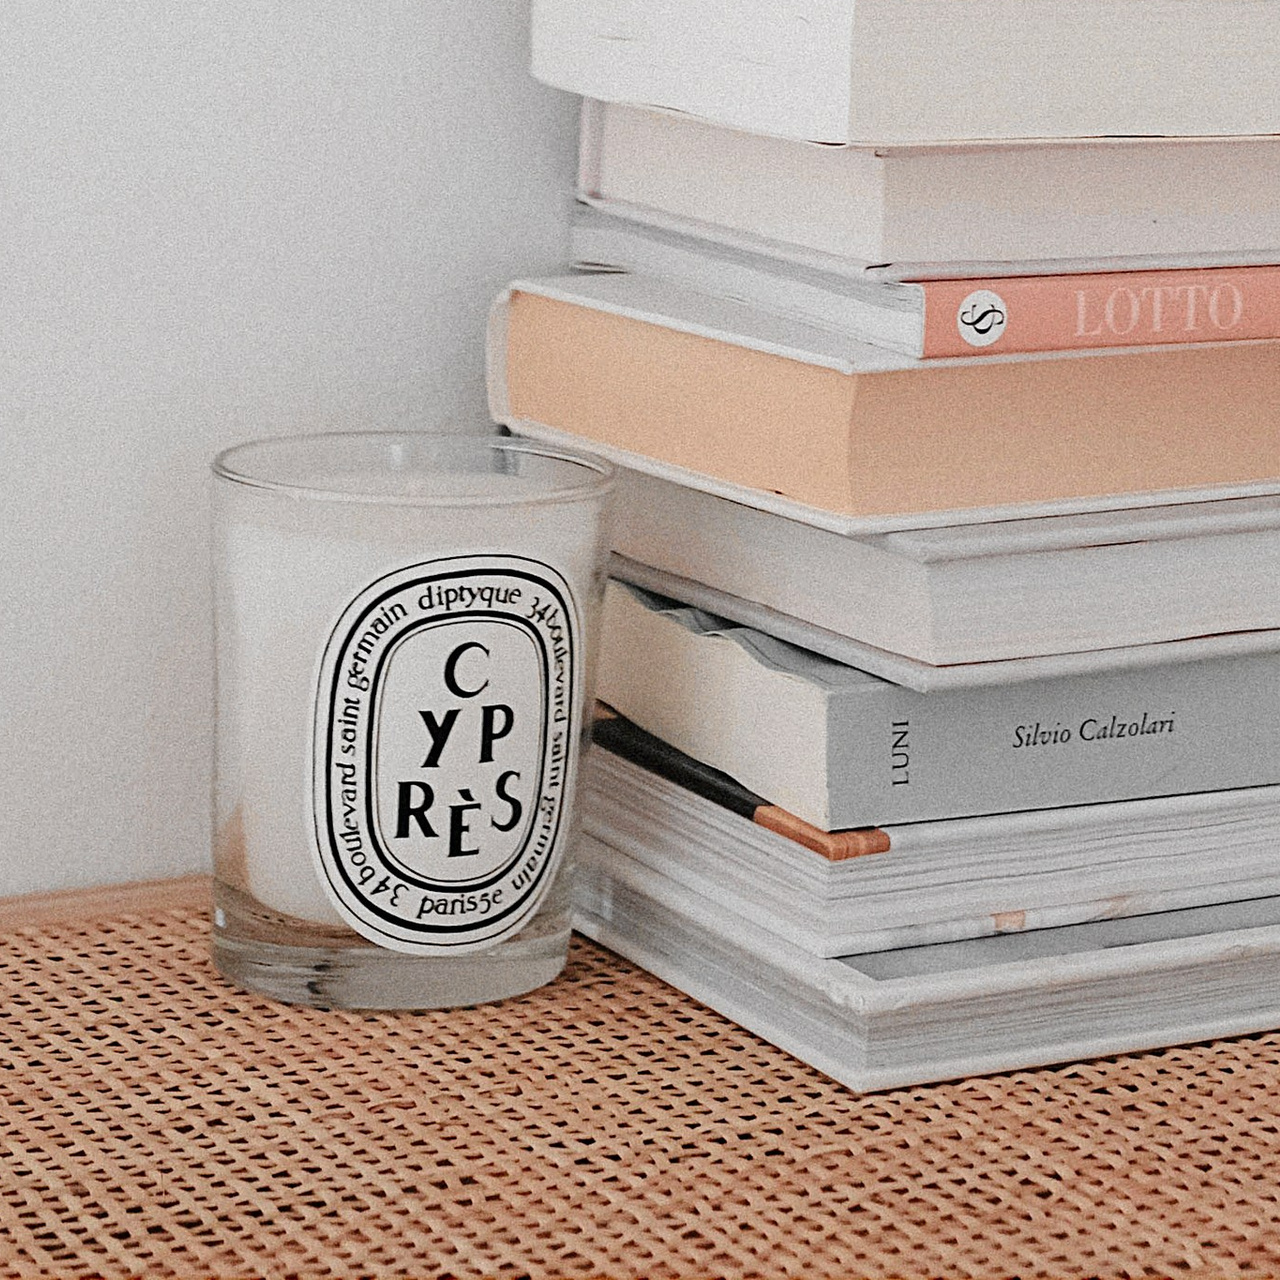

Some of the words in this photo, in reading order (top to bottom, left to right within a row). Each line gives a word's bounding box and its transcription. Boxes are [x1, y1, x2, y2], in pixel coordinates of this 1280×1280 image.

[1073, 282, 1244, 337] LOTTO
[417, 584, 522, 612] diptyque
[346, 601, 409, 692] germain
[337, 696, 361, 757] saint
[891, 719, 910, 786] LUNI
[1012, 721, 1072, 749] Silvio
[1078, 710, 1176, 742] Calzolari
